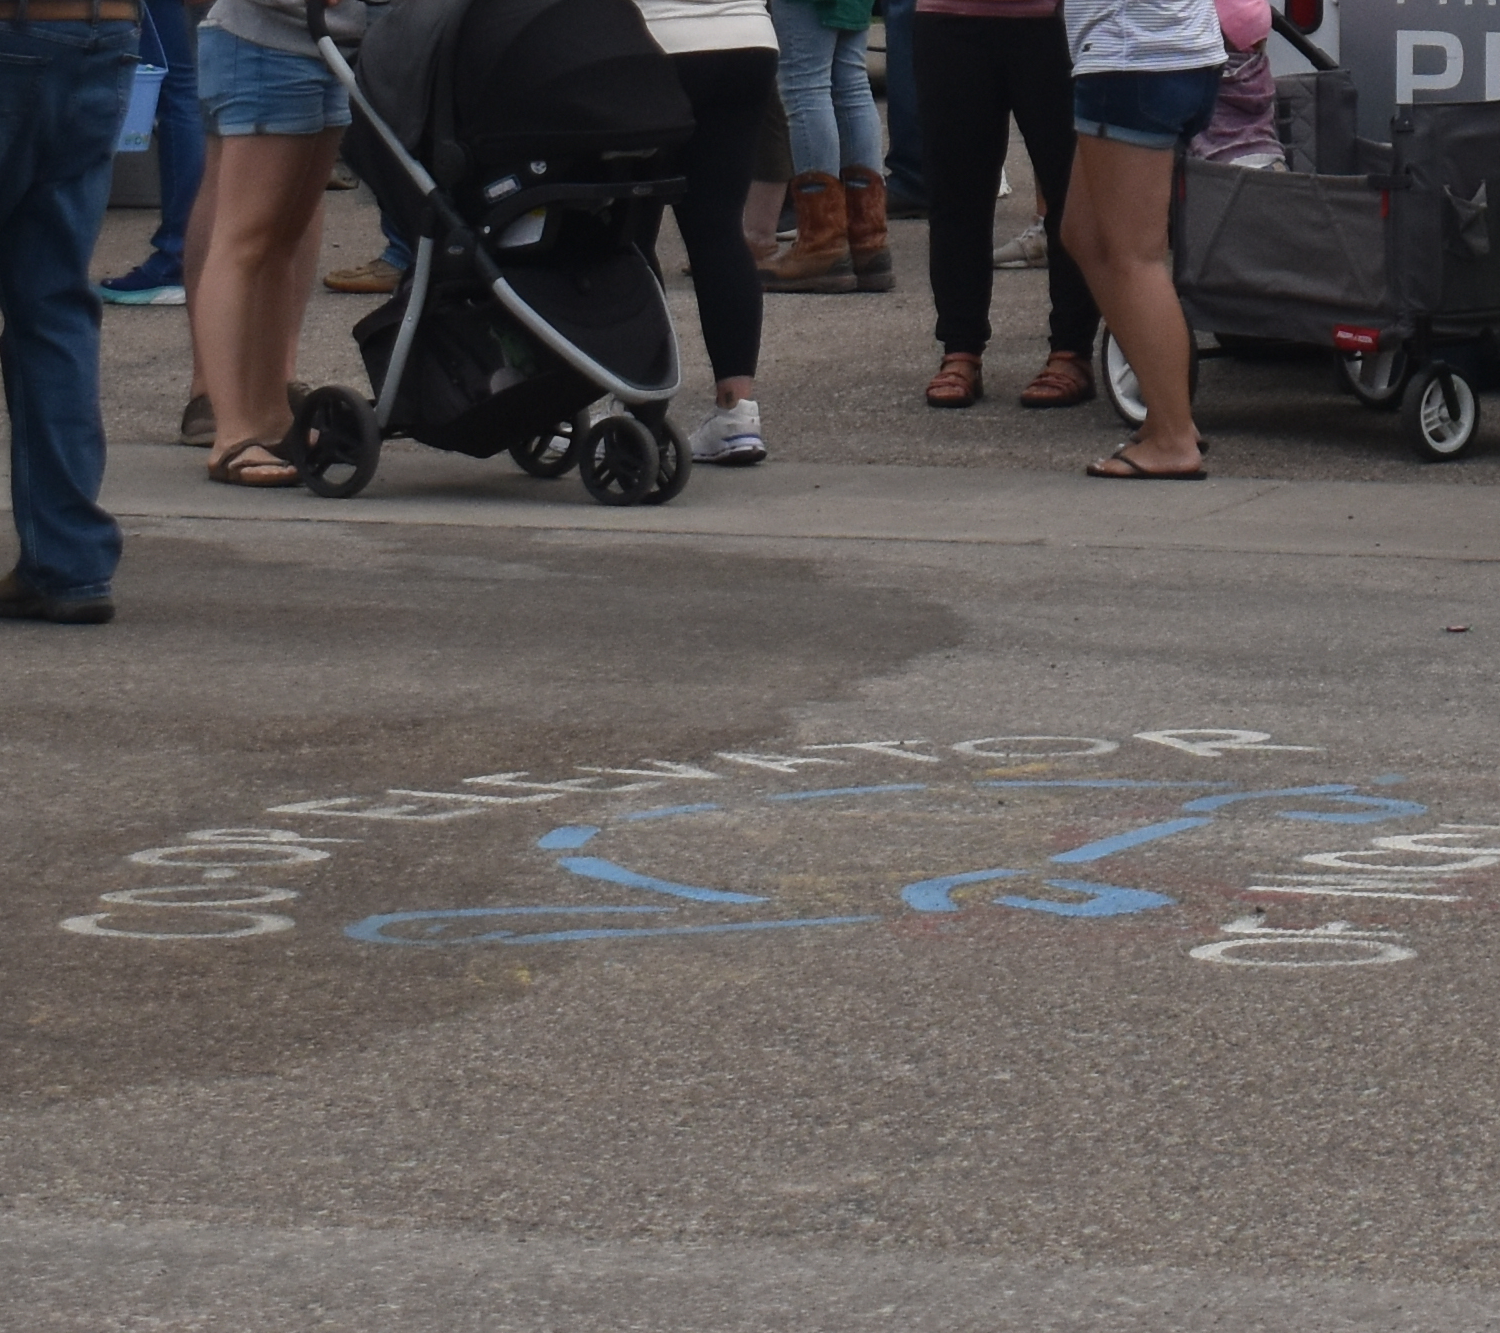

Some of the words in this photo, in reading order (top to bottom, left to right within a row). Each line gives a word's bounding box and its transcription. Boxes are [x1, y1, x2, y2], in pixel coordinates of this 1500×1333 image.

[60, 827, 362, 940] CO-OP
[266, 728, 1327, 822] ELEVATOR
[1189, 914, 1419, 969] OF
